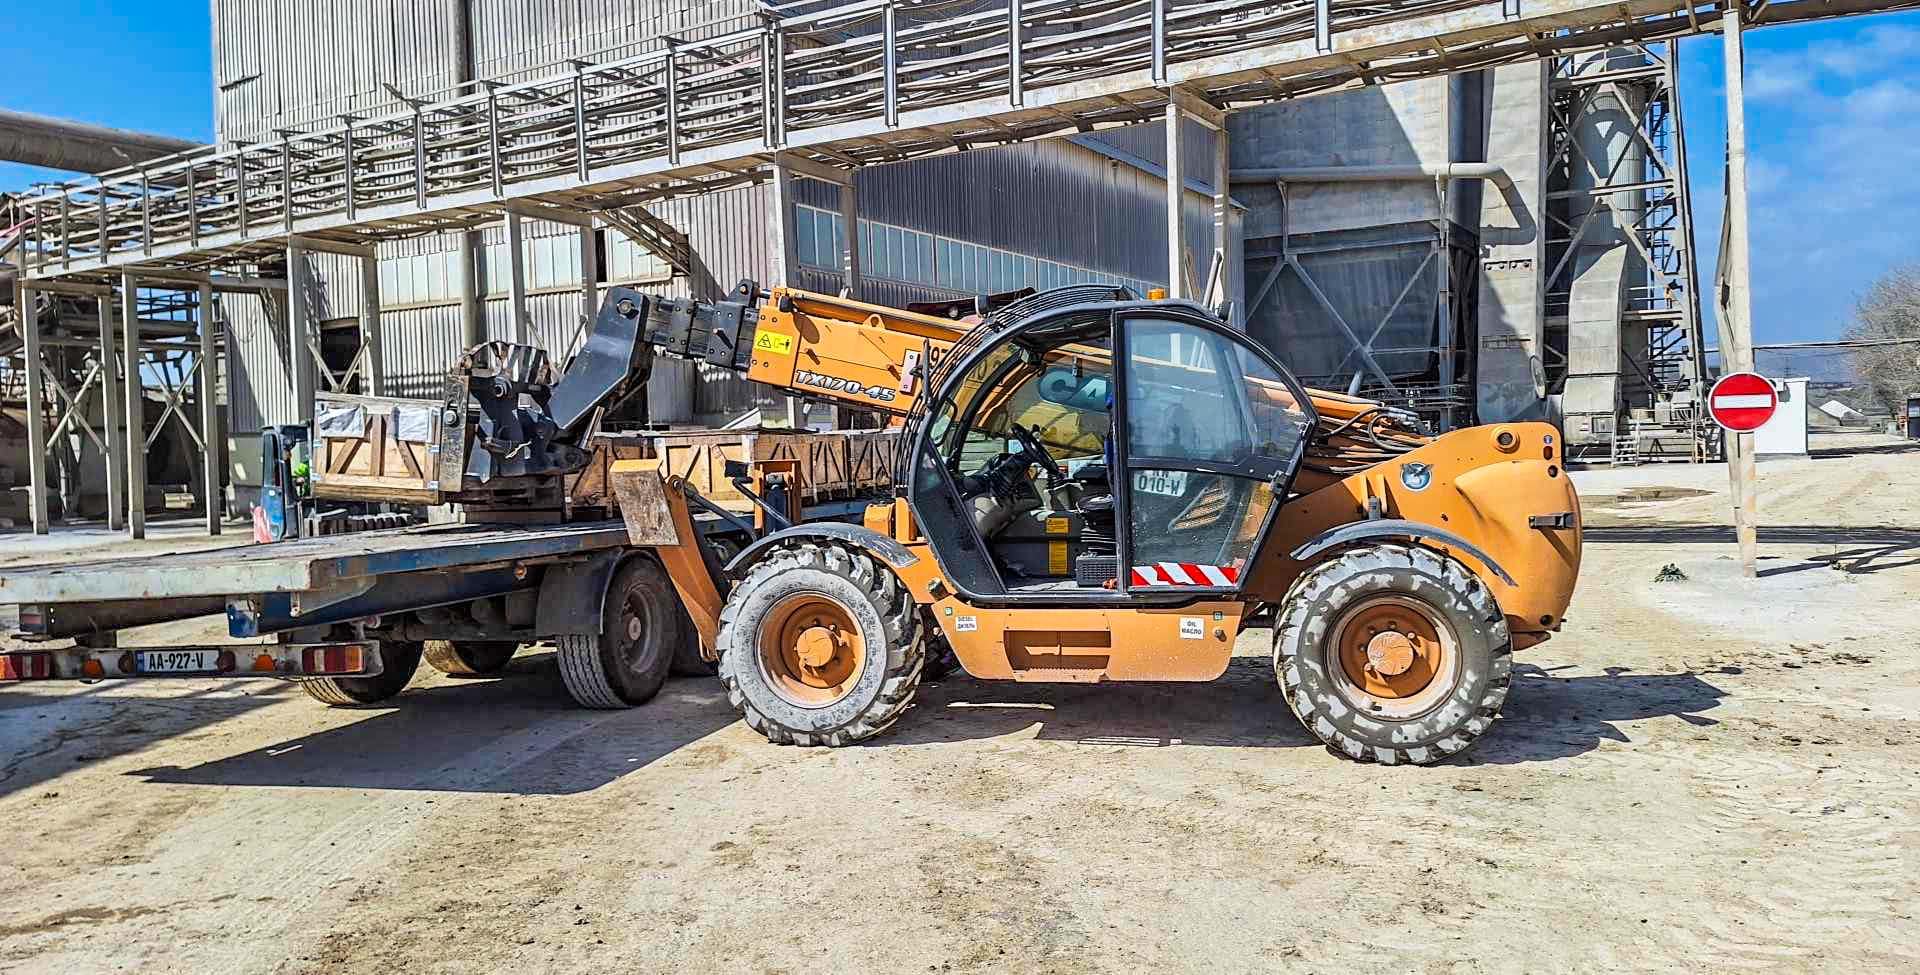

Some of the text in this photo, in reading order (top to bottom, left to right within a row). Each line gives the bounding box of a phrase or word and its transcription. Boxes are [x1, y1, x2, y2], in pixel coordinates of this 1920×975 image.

[796, 369, 897, 402] TX170-45
[1138, 475, 1180, 495] 010-W
[148, 652, 204, 670] AA-927-V
